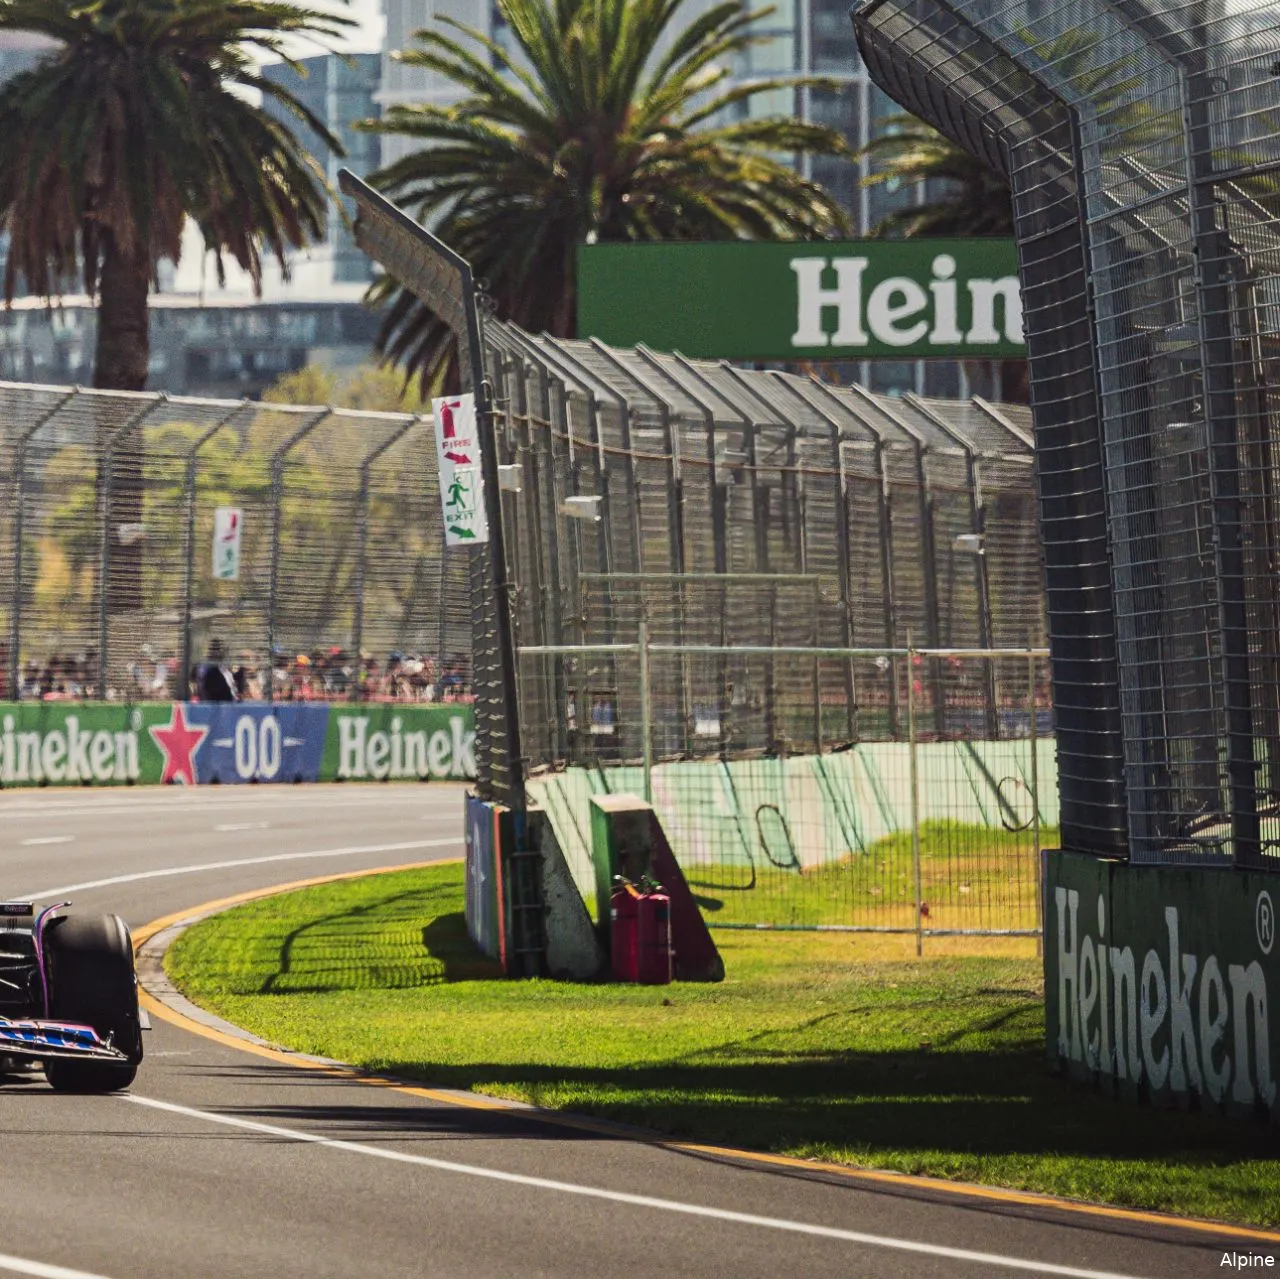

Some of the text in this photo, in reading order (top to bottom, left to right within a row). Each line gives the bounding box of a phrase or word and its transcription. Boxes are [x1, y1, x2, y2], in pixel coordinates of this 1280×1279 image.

[790, 254, 1026, 347] Hein
[441, 439, 472, 449] FIRE
[446, 512, 475, 522] EXIT
[1055, 886, 1277, 1109] Heineken
